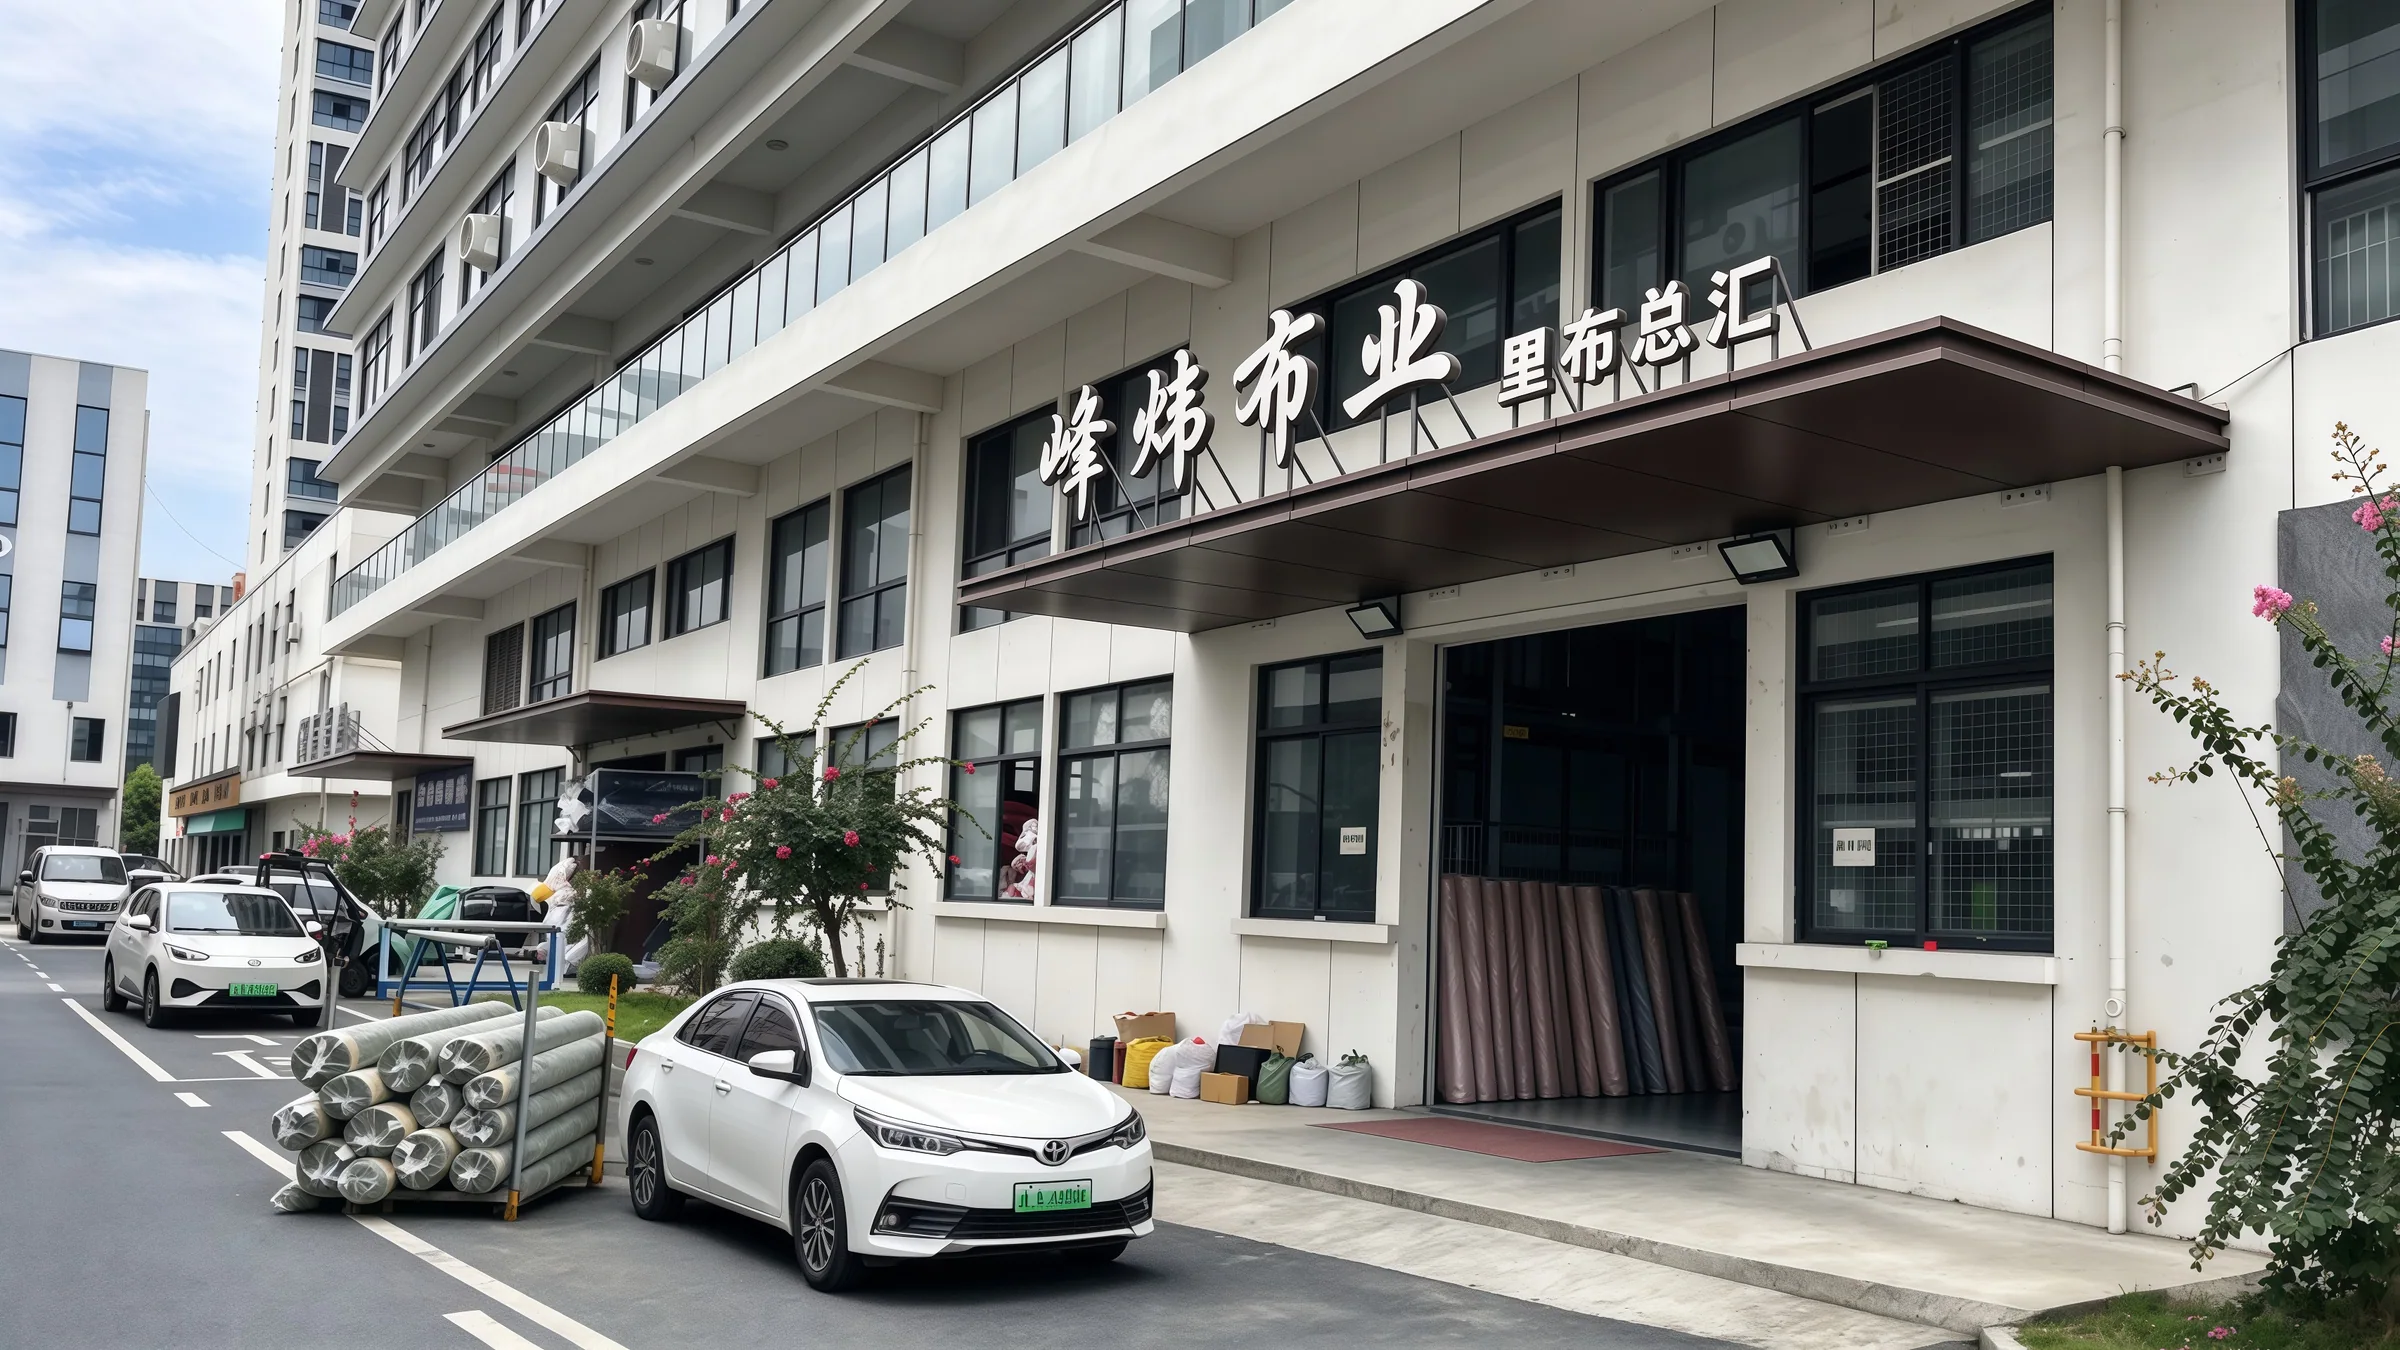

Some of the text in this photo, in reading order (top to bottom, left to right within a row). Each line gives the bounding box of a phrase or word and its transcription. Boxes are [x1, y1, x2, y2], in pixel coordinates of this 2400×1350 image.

[1039, 255, 1779, 521] 峰炜布业 里布总汇
